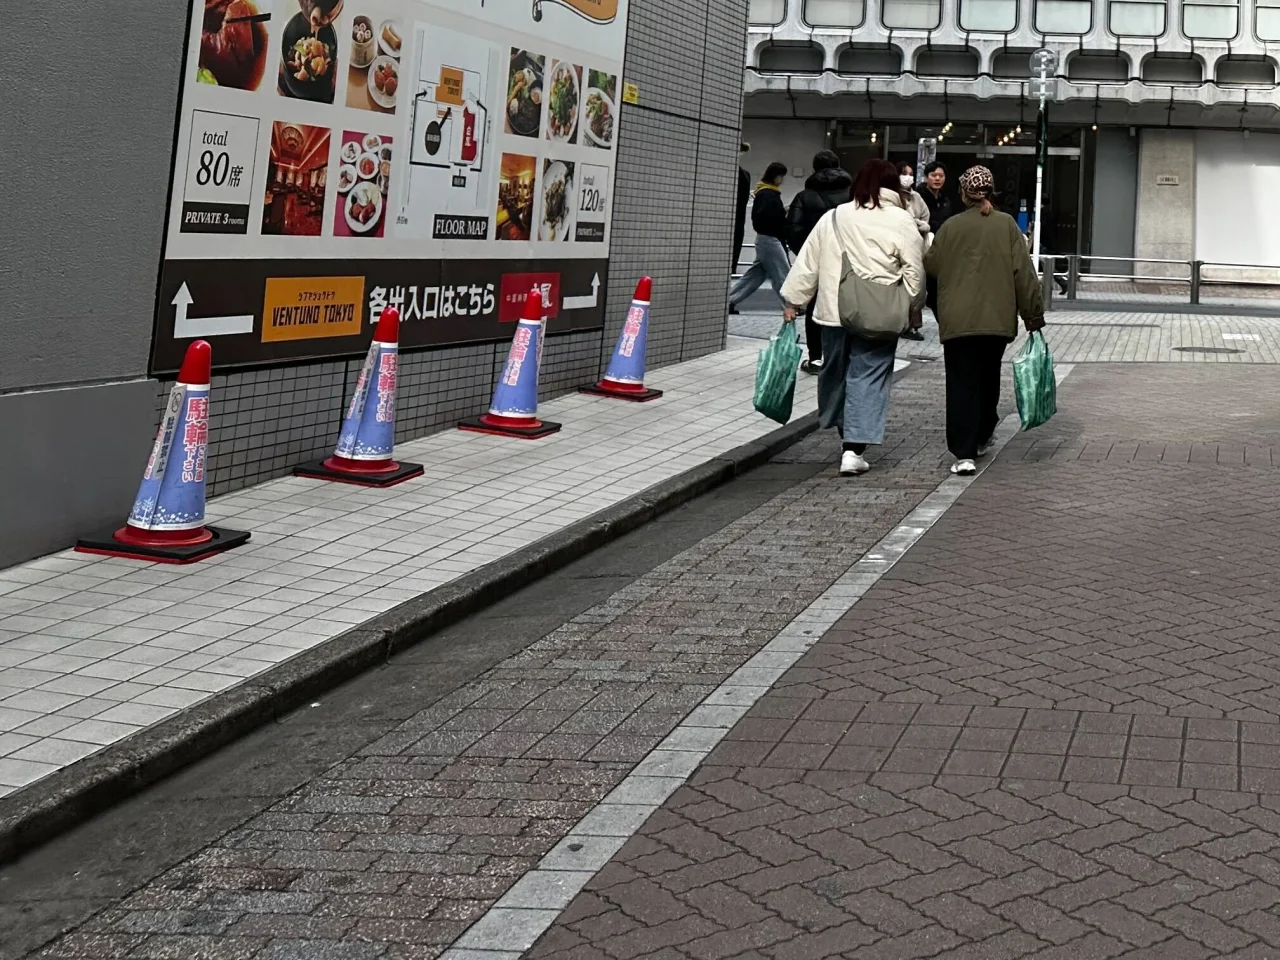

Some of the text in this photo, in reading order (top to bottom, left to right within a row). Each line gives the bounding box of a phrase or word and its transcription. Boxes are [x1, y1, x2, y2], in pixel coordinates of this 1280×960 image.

[202, 130, 228, 146] total
[196, 150, 243, 188] 80席
[185, 211, 222, 224] PRIVATE
[435, 218, 487, 236] FLOOR MAP
[368, 283, 495, 325] 各出入口はこちら
[272, 303, 355, 328] VENTUNO TOKYO
